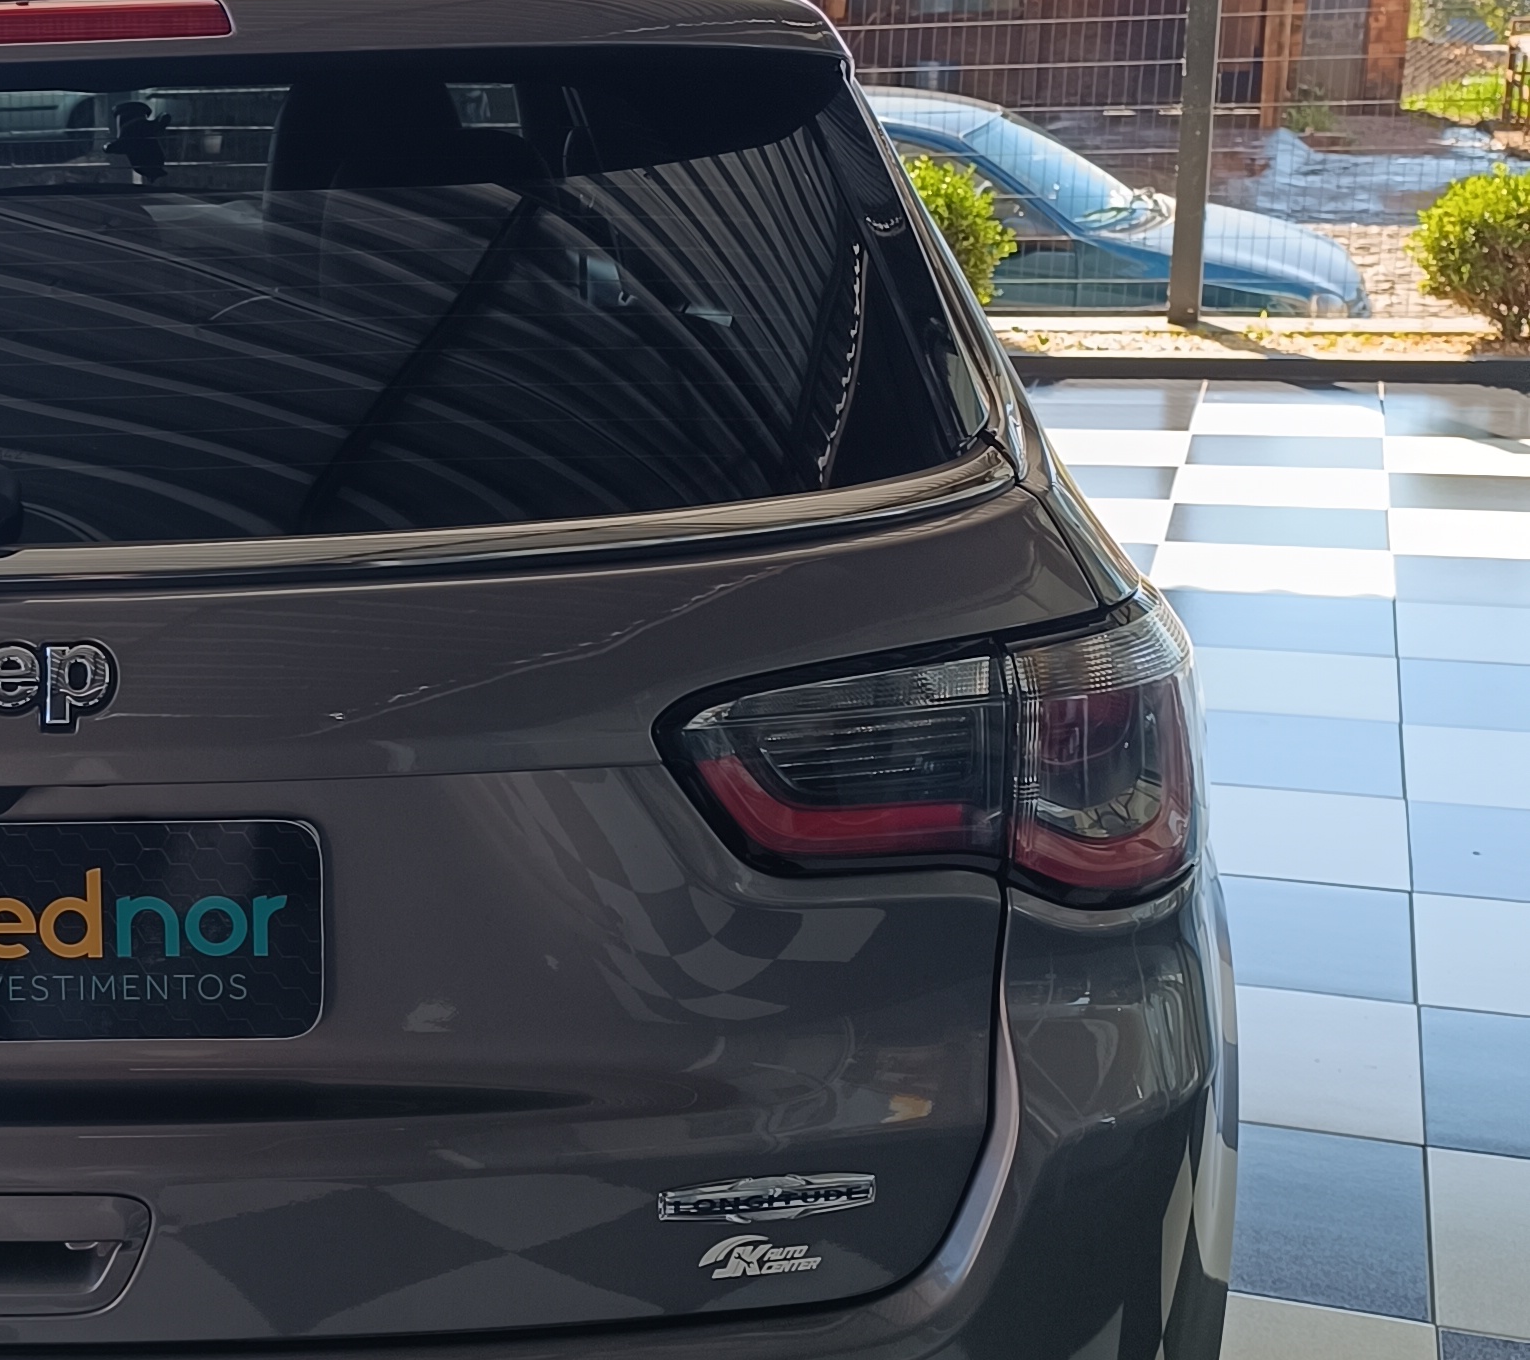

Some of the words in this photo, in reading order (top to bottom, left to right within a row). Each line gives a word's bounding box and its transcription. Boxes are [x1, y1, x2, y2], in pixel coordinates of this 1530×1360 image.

[673, 1186, 869, 1214] LONGITUDE
[765, 1244, 809, 1259] AUTO
[760, 1256, 822, 1274] CENTER
